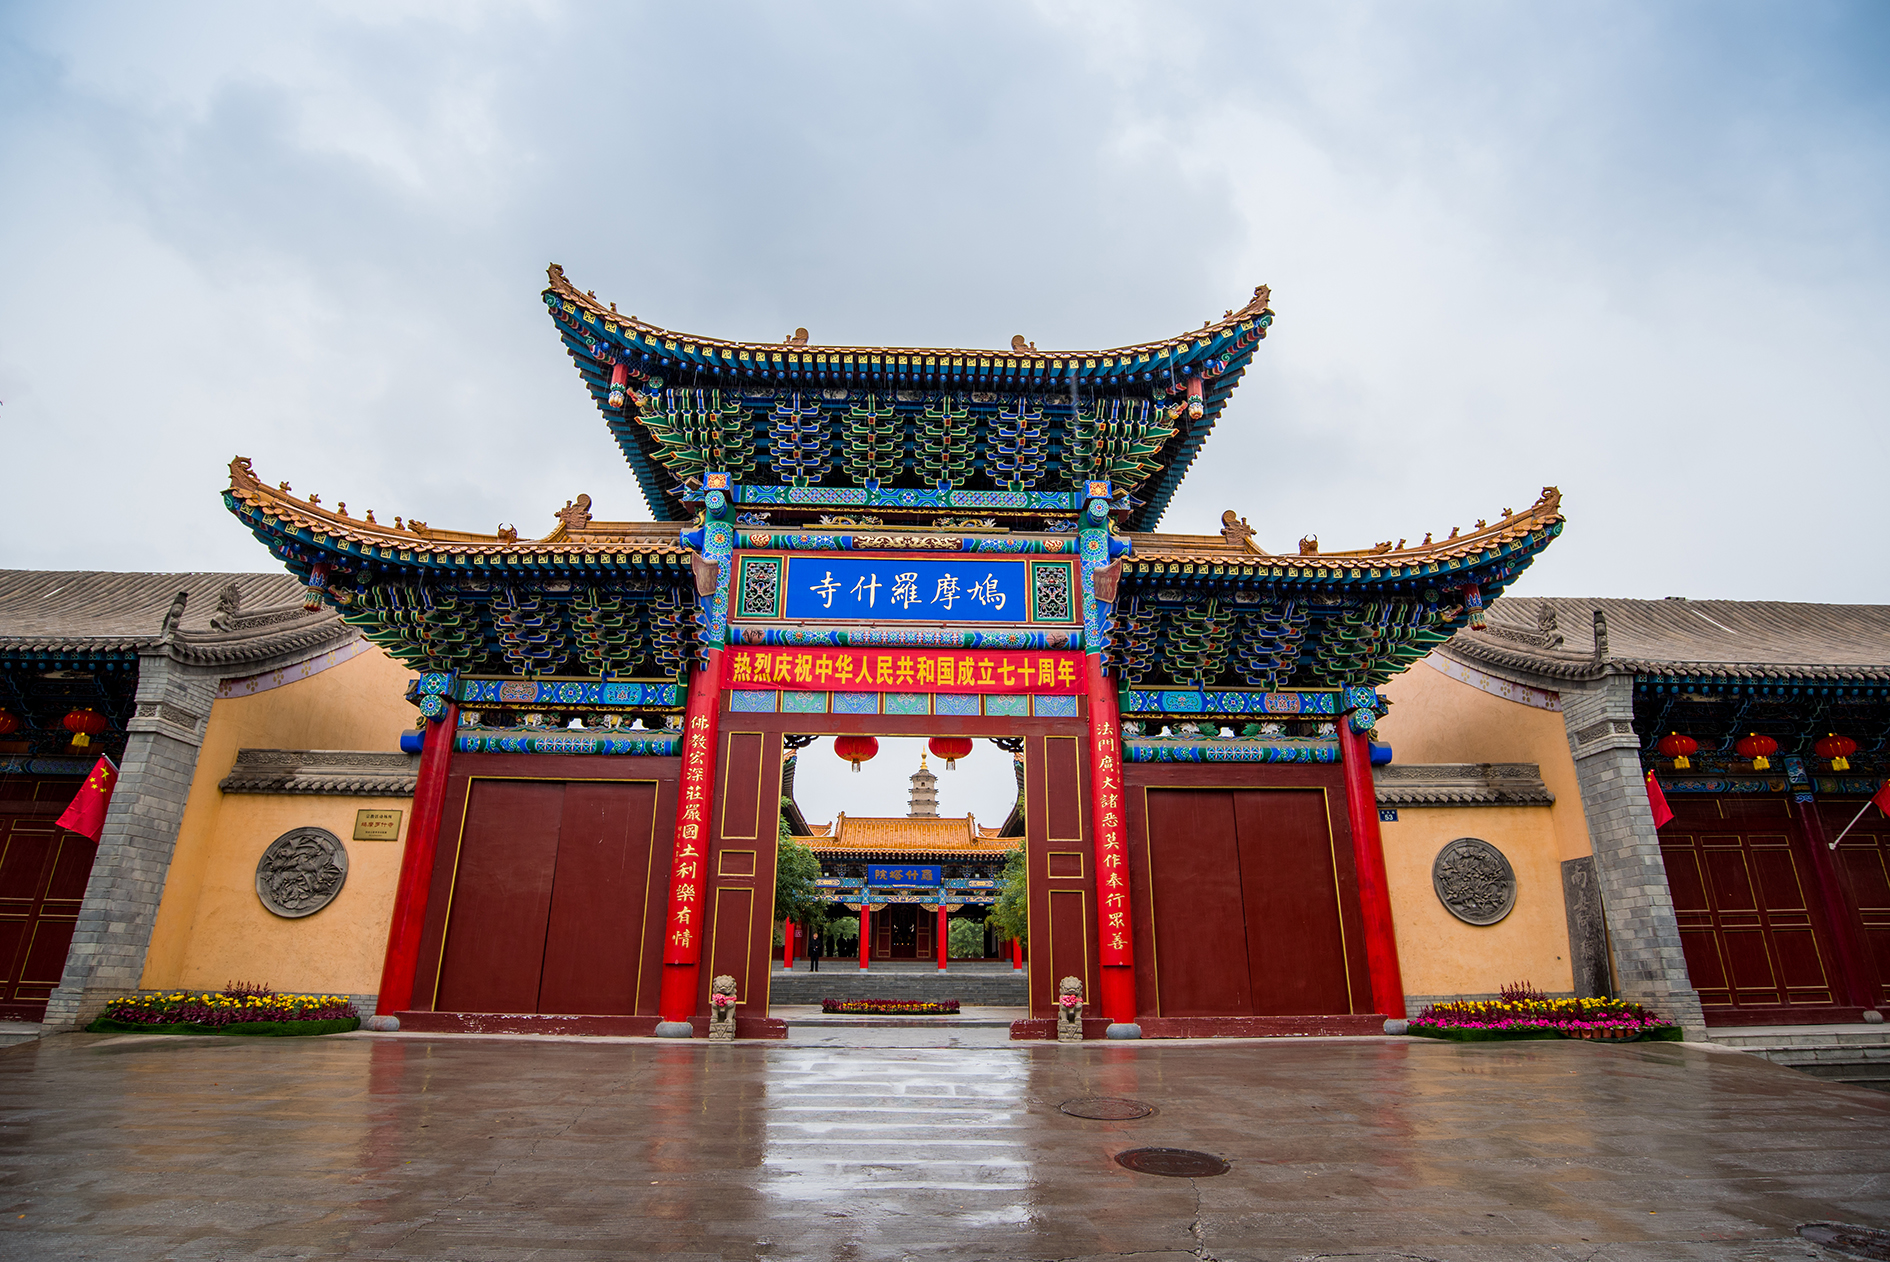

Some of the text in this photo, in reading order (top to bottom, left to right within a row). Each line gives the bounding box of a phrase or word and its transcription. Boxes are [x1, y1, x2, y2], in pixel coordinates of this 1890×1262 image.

[733, 651, 1076, 688] 热烈庆祝中华人民共和国成立七十周年
